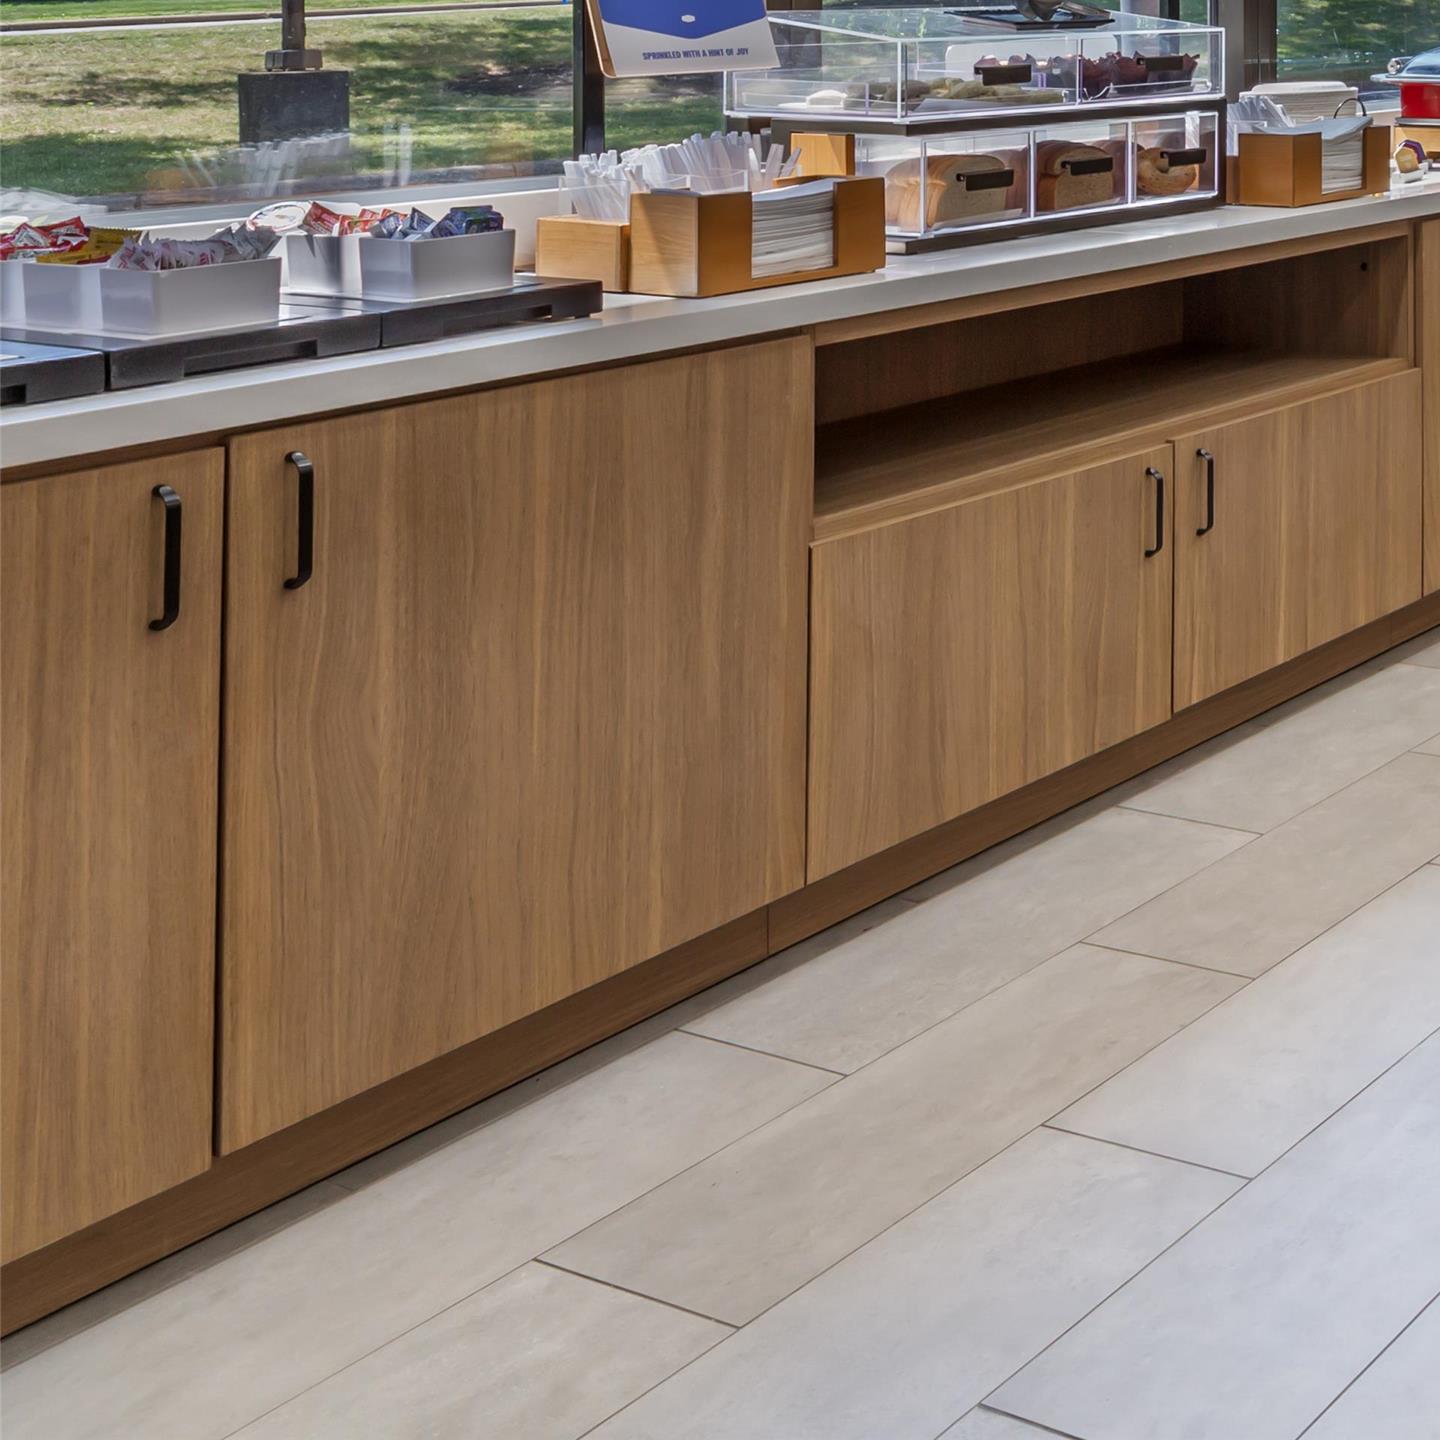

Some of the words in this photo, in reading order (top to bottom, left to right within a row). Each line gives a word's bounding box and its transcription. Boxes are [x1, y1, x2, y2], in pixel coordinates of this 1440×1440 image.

[642, 50, 682, 60] SPRINKLED
[683, 49, 700, 59] WITH
[702, 49, 708, 57] A
[709, 48, 724, 57] HINT
[725, 48, 734, 56] OF
[736, 47, 749, 56] JOY
